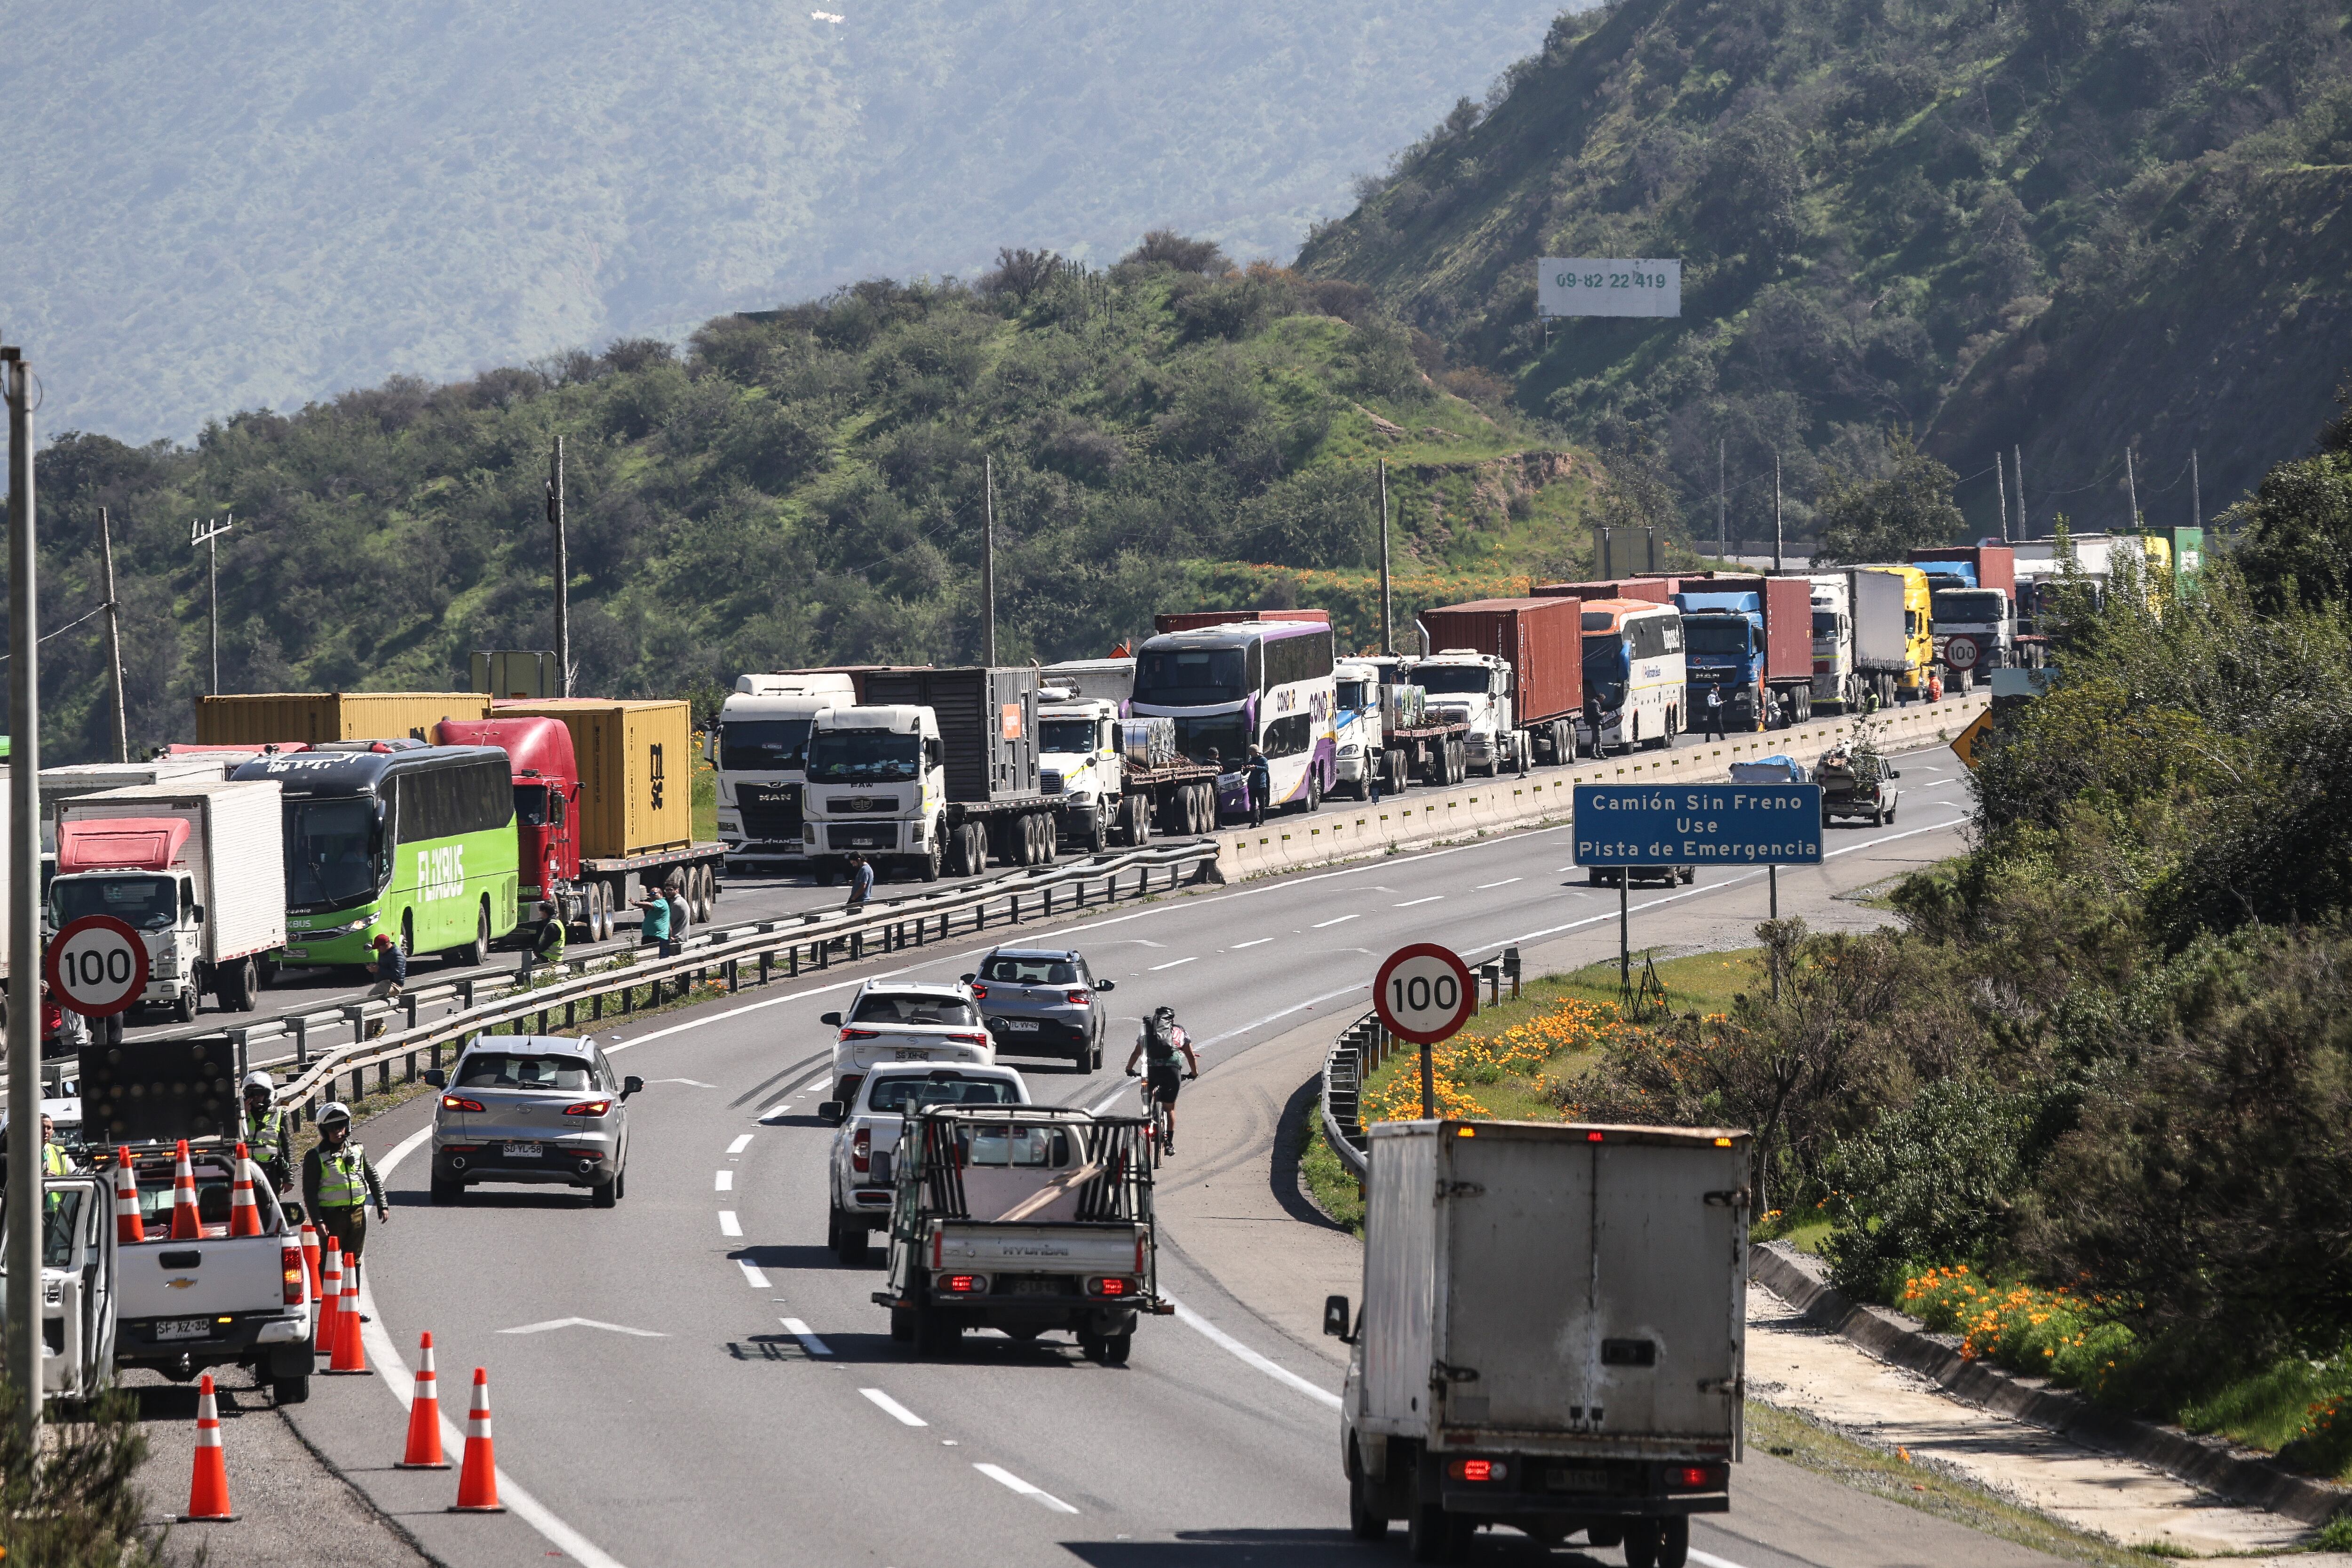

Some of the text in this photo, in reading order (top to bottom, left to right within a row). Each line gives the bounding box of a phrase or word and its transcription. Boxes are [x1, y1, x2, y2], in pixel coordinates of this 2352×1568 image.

[1609, 273, 1629, 288] 22
[1634, 273, 1667, 288] 419
[1951, 646, 1976, 660] 100
[1277, 689, 1296, 713] CONDOR
[1309, 689, 1337, 725] CONDOR
[1592, 791, 1802, 811] Camión Sin Freno
[1677, 818, 1718, 833] Use
[1579, 840, 1817, 860] Pista de Emergencia
[64, 948, 131, 987] 100
[1392, 975, 1457, 1012] 100
[1002, 1247, 1068, 1256] HYUNDAI
